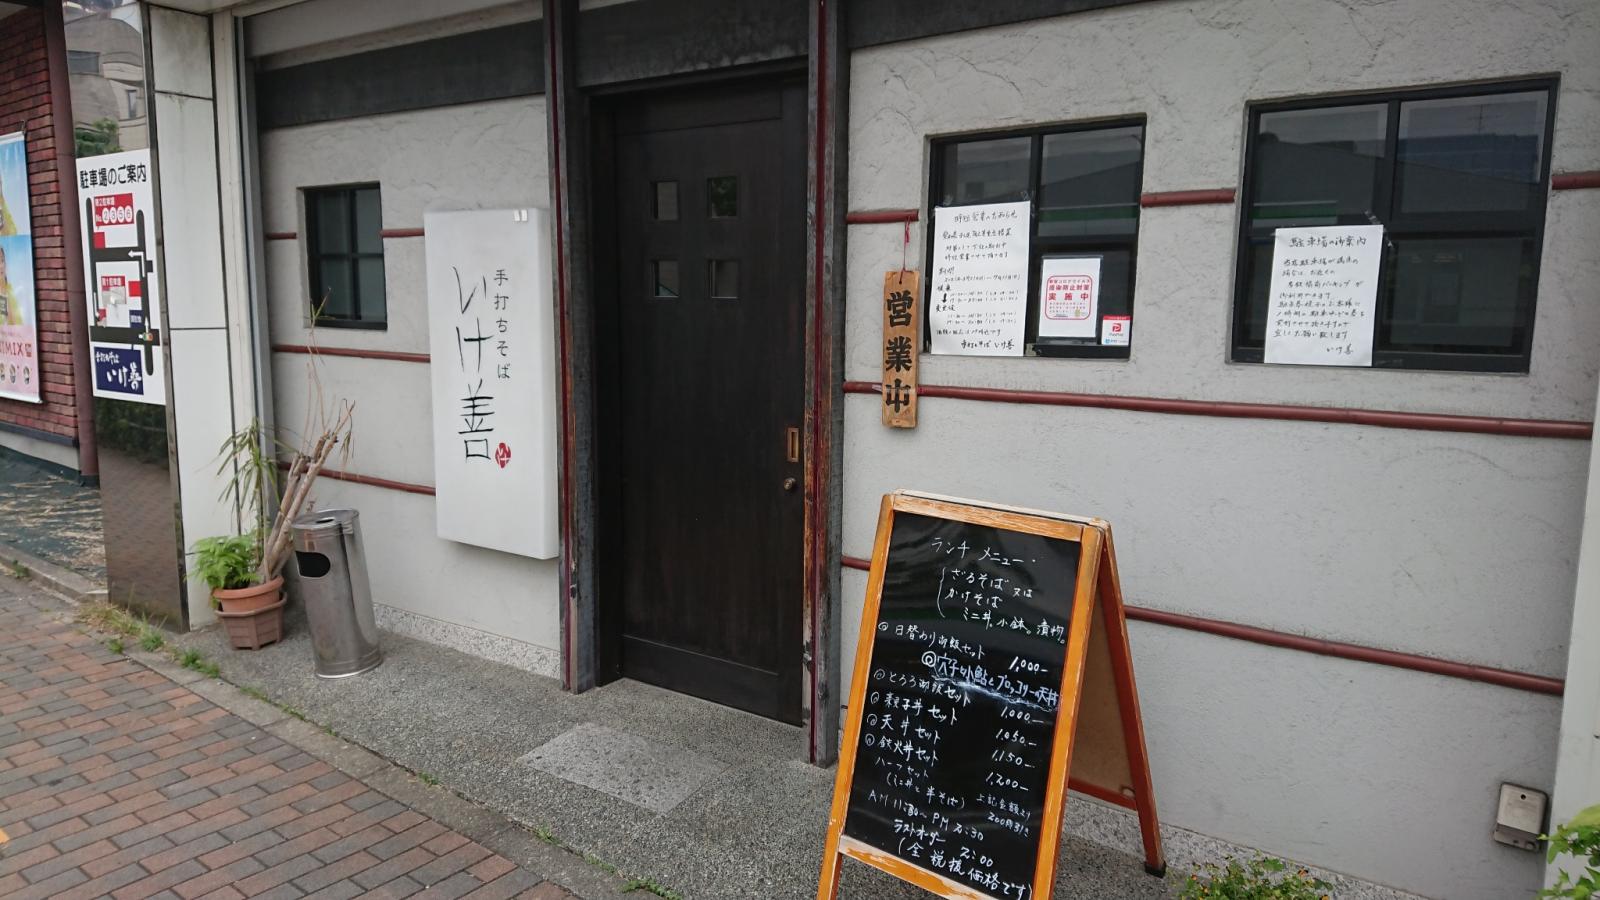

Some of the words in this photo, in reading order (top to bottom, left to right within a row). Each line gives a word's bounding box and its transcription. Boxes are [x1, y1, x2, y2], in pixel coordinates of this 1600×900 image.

[80, 163, 148, 189] 駐車場のご案内
[1048, 292, 1089, 301] 実施中
[493, 269, 512, 380] 手打ちそば
[452, 265, 495, 463] いけ善
[885, 289, 914, 414] 営業中
[931, 537, 971, 560] ランチ
[951, 568, 1010, 592] ざるそば
[1013, 587, 1034, 599] 又は
[945, 588, 1004, 609] かけそば
[893, 818, 947, 846] ラストオーダー
